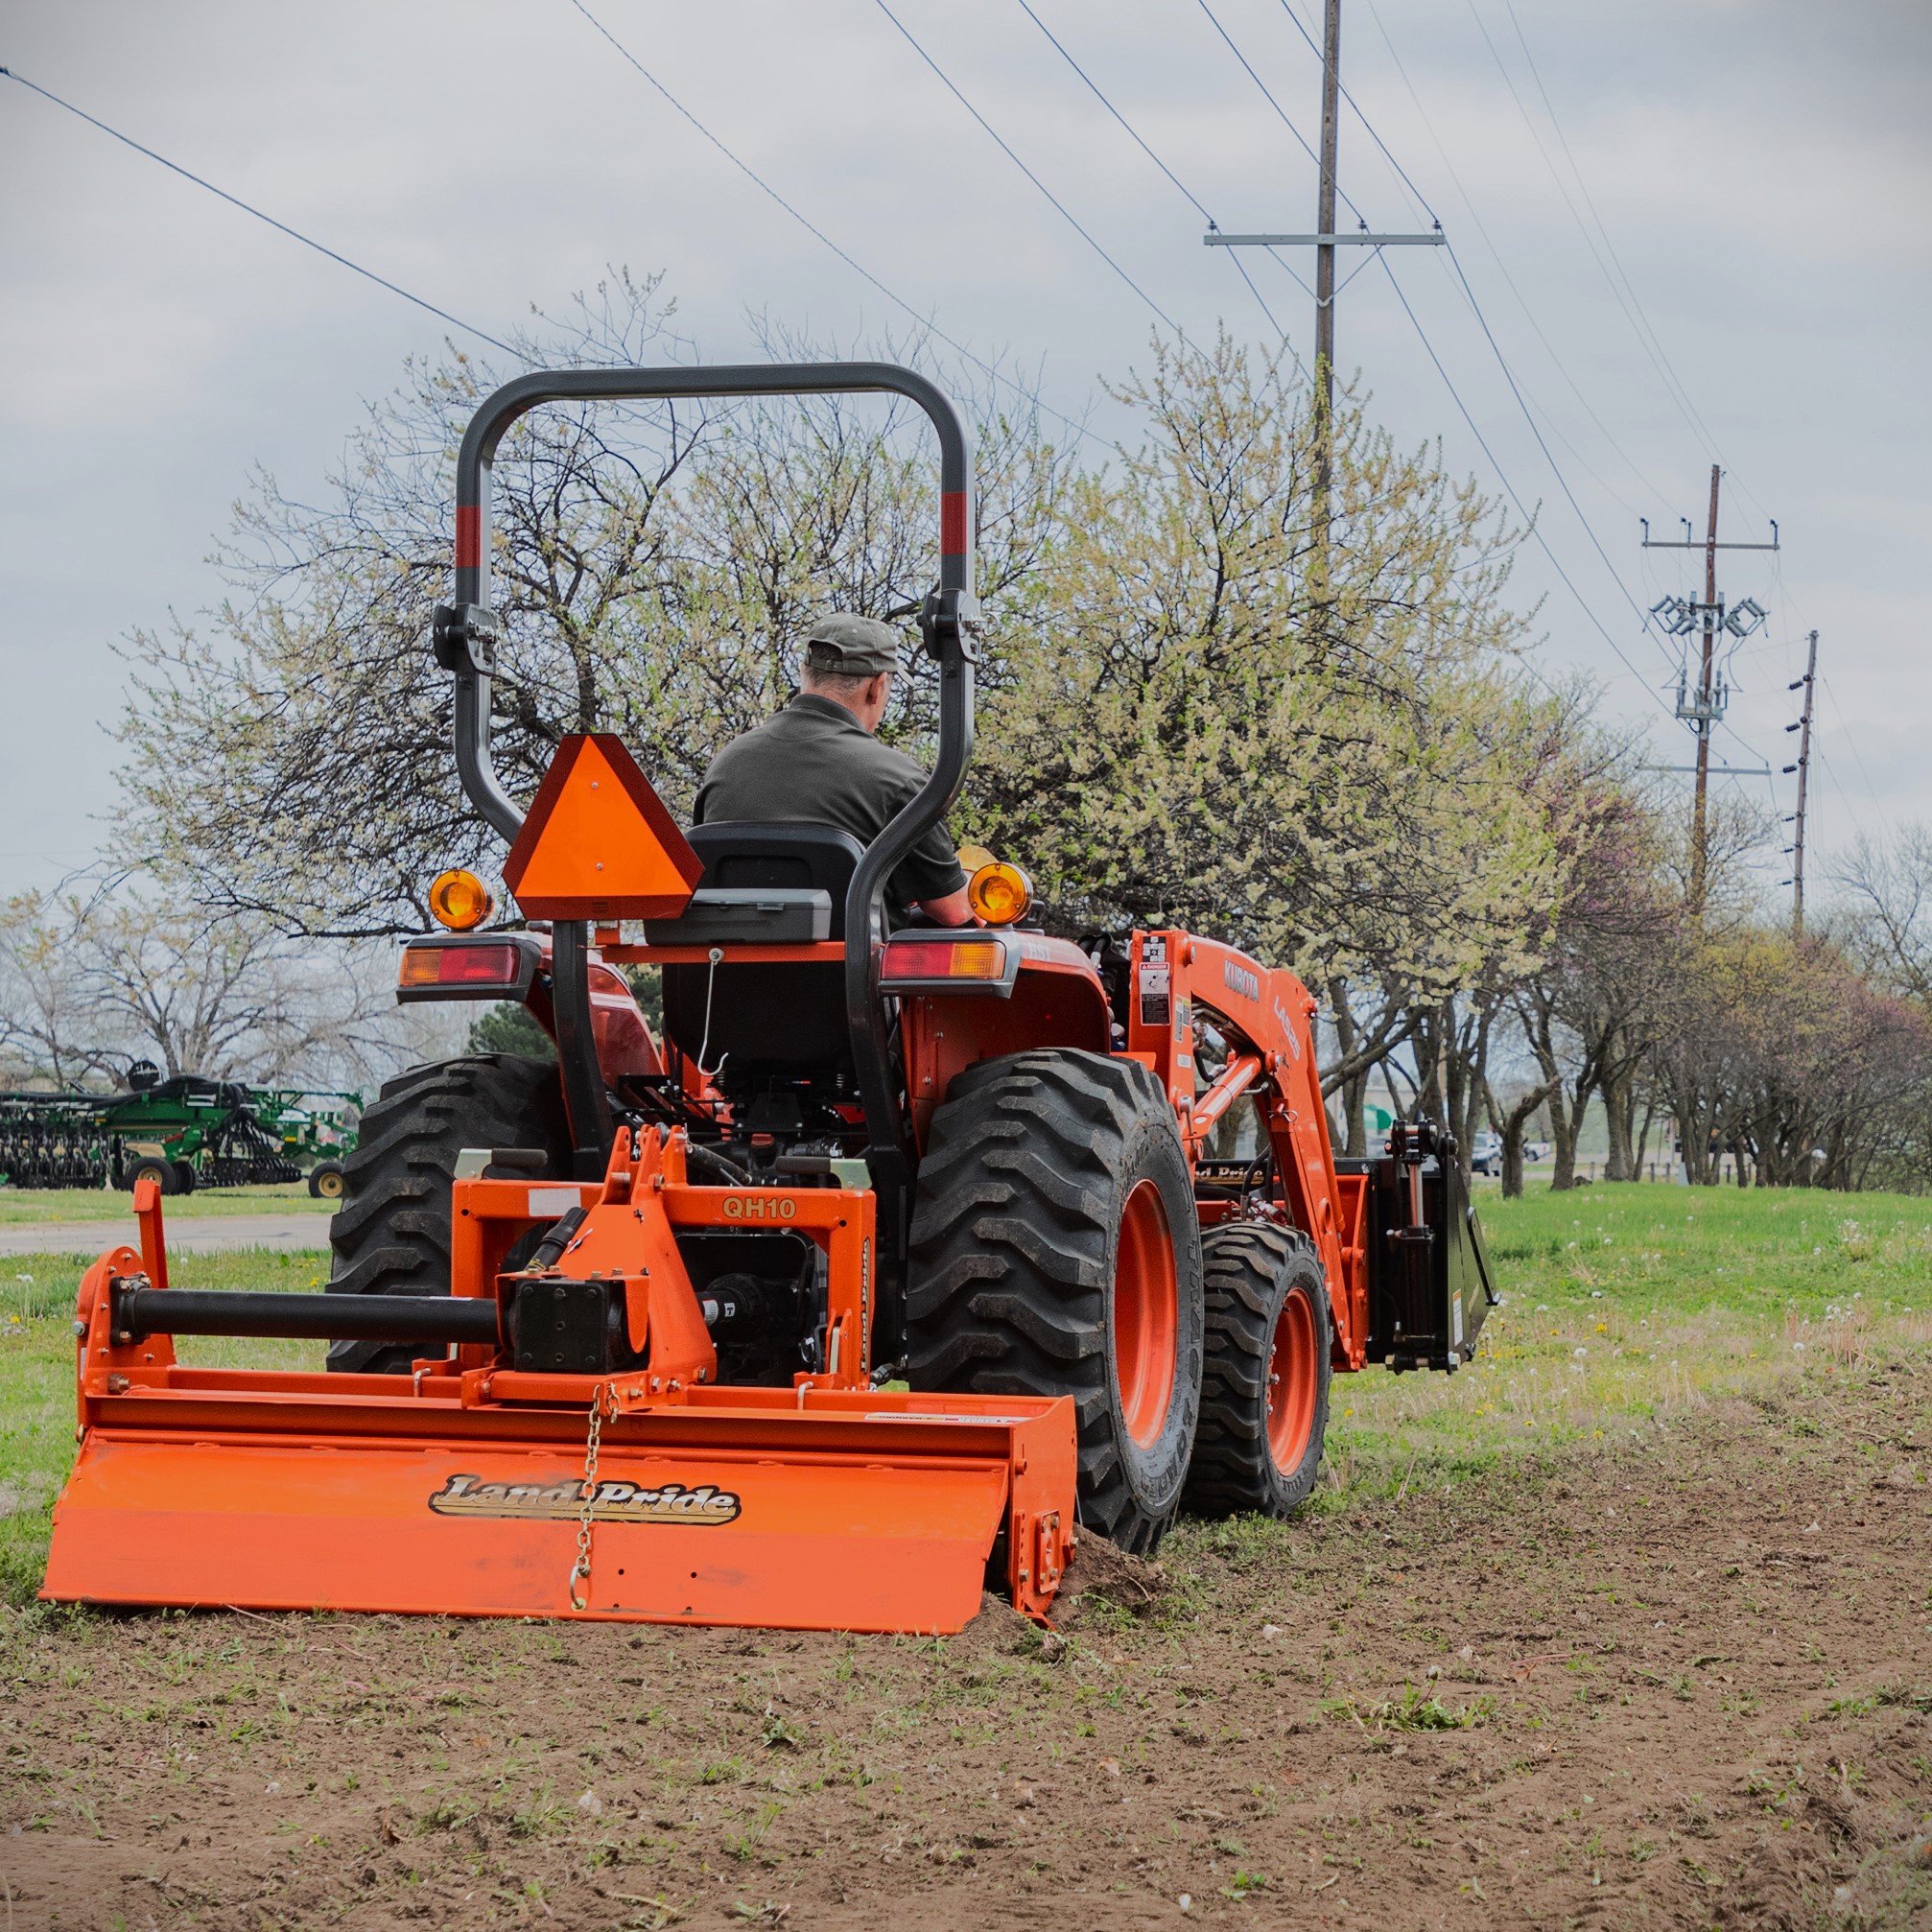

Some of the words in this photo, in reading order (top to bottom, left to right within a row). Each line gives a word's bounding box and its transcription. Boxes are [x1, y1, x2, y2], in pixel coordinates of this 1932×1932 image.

[1224, 959, 1260, 1004] KUBOTA
[1273, 995, 1302, 1061] LA525
[722, 1196, 797, 1219] QH10
[438, 1475, 584, 1508] Land
[593, 1482, 738, 1514] Pride
